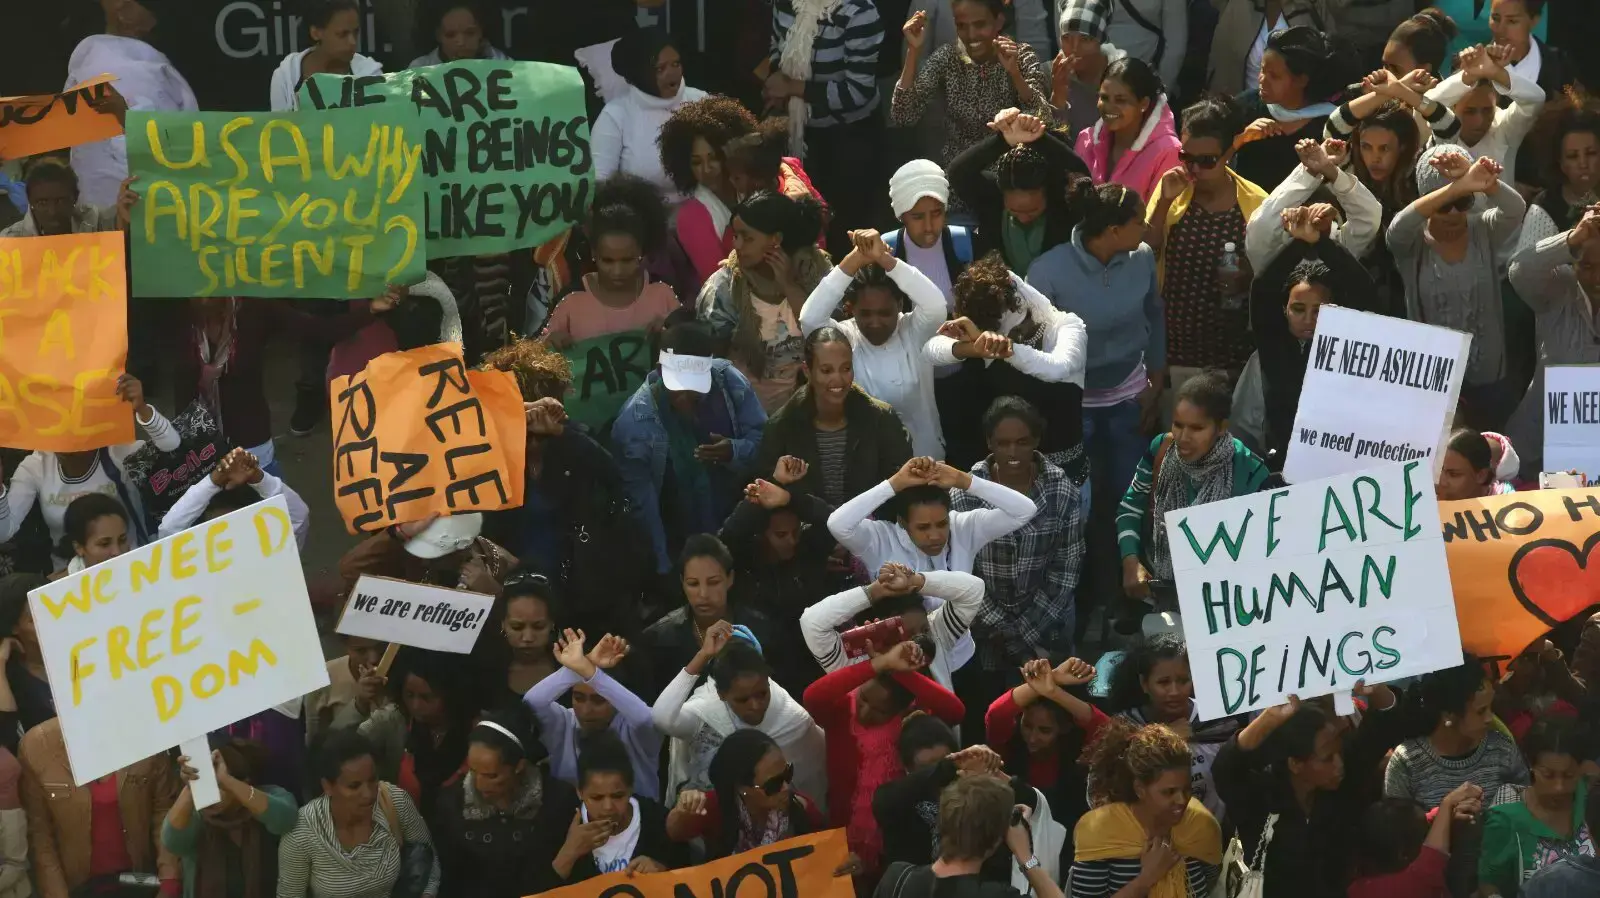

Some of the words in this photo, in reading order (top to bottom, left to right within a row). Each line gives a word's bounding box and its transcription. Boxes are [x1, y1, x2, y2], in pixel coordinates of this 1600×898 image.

[411, 68, 518, 122] ARE
[147, 117, 312, 185] USA
[323, 122, 422, 204] WHY
[145, 181, 261, 251] ARE
[259, 188, 381, 245] YOU
[510, 178, 589, 239] YOU
[38, 309, 75, 360] A
[1314, 334, 1340, 372] WE
[1338, 340, 1380, 379] NEED
[1379, 347, 1454, 393] ASYLLUM!
[418, 358, 508, 508] RELE
[1548, 391, 1568, 424] WE
[1573, 391, 1600, 424] NEE
[150, 443, 216, 496] Bella
[1300, 427, 1317, 446] we
[1320, 432, 1355, 452] need
[1178, 489, 1290, 565] WE
[1318, 461, 1422, 554] ARE
[354, 593, 378, 613] we
[380, 598, 412, 618] are
[413, 602, 485, 632] reffuge!
[69, 595, 203, 707] FREE
[151, 638, 277, 723] DOM
